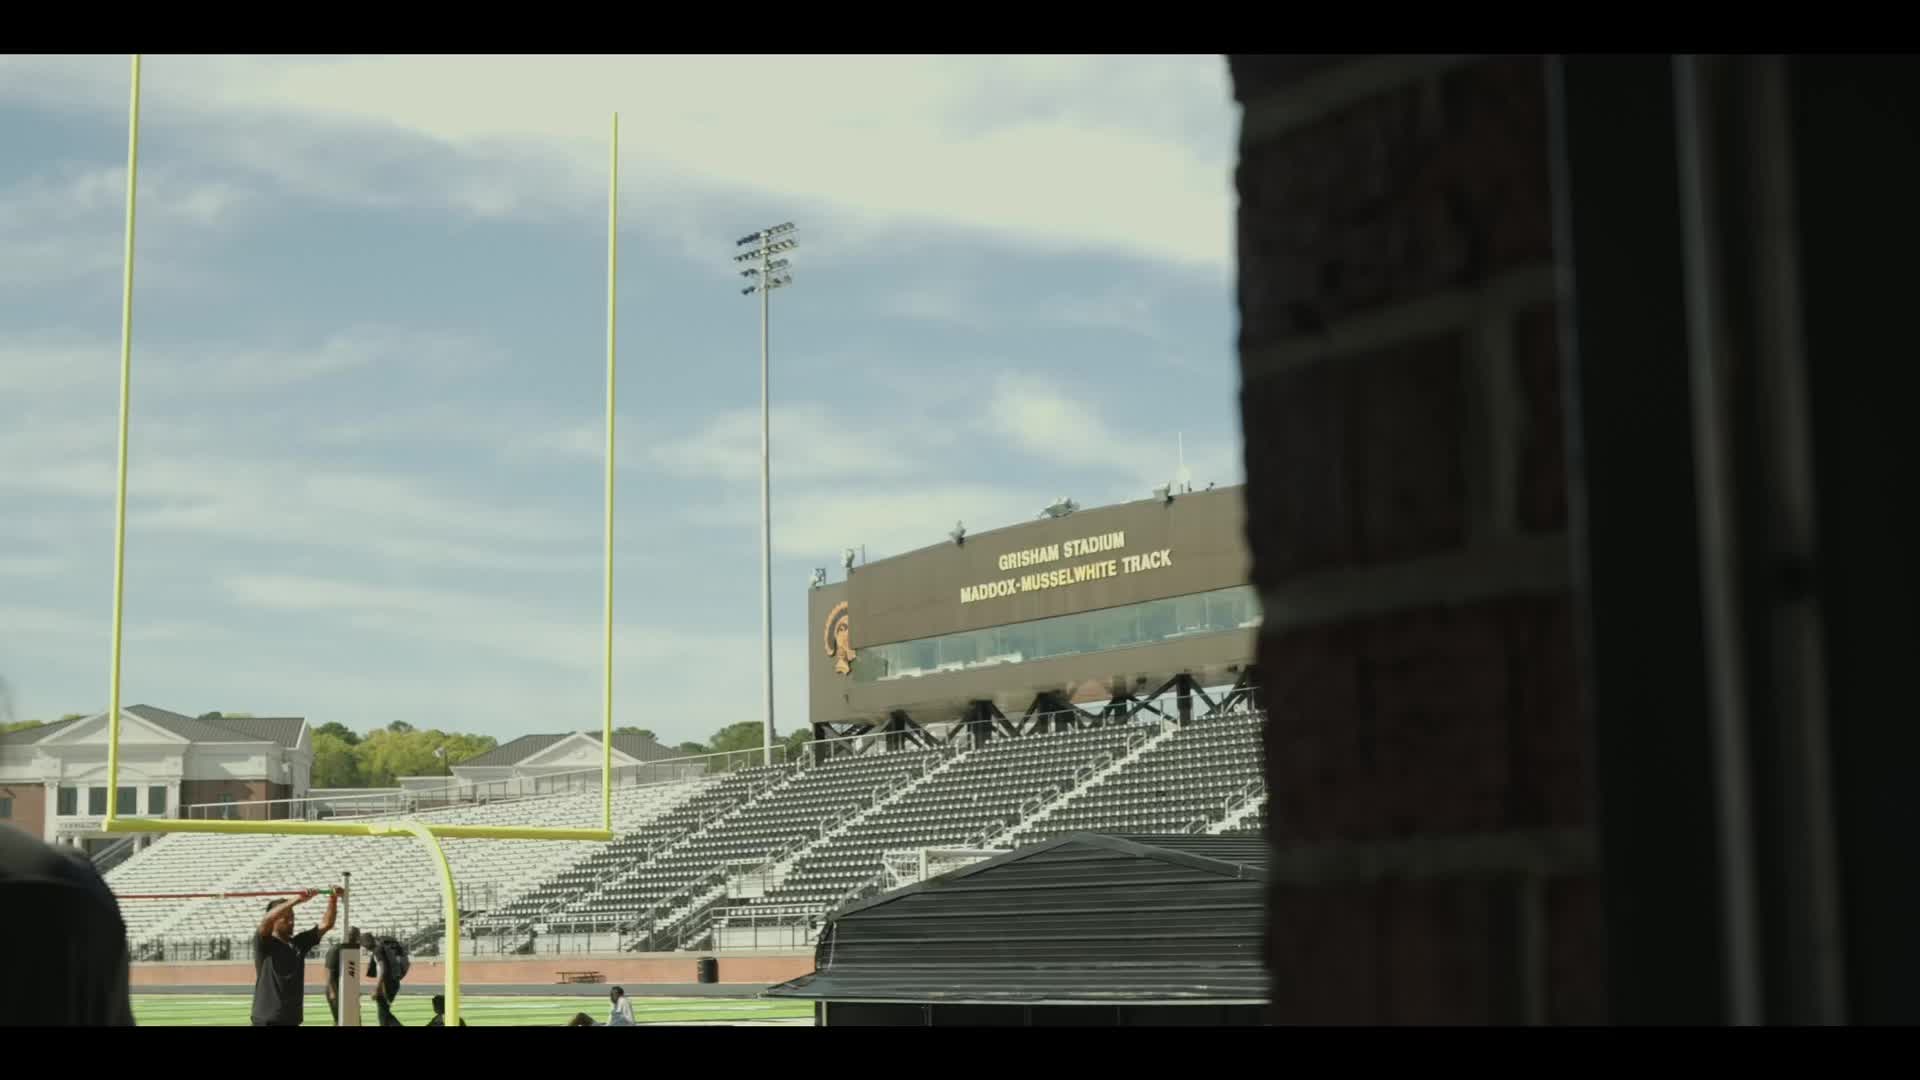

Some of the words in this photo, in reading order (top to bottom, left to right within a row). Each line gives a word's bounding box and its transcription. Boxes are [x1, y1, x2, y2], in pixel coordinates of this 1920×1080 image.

[998, 544, 1060, 571] GRISHAM
[1063, 531, 1125, 558] STADIUM
[960, 560, 1117, 604] MADDOX-MUSSELWHITE
[1122, 550, 1172, 574] TRACK
